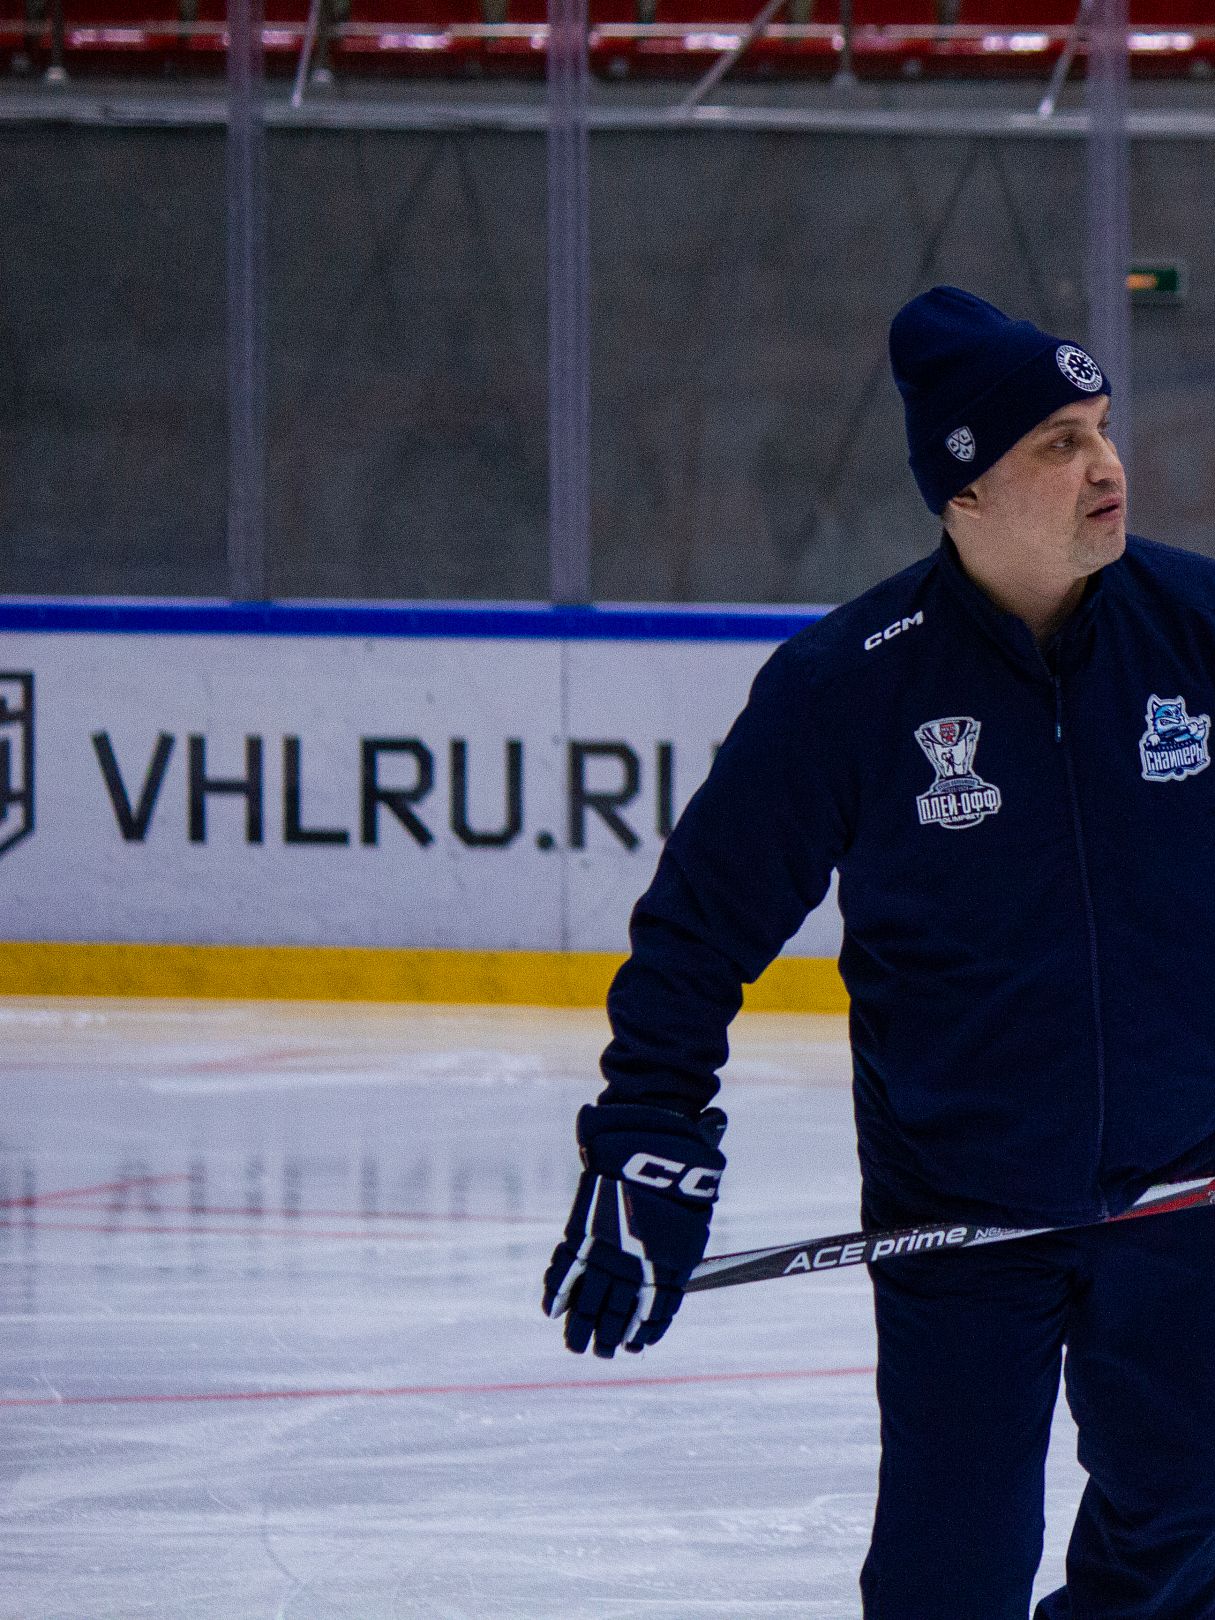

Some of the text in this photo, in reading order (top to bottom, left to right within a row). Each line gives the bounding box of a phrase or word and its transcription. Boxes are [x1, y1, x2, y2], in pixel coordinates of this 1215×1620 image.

[864, 610, 924, 651] CCM
[920, 789, 997, 820] ПЛЕЙ-ОФФ
[783, 1226, 968, 1274] ACE prime
